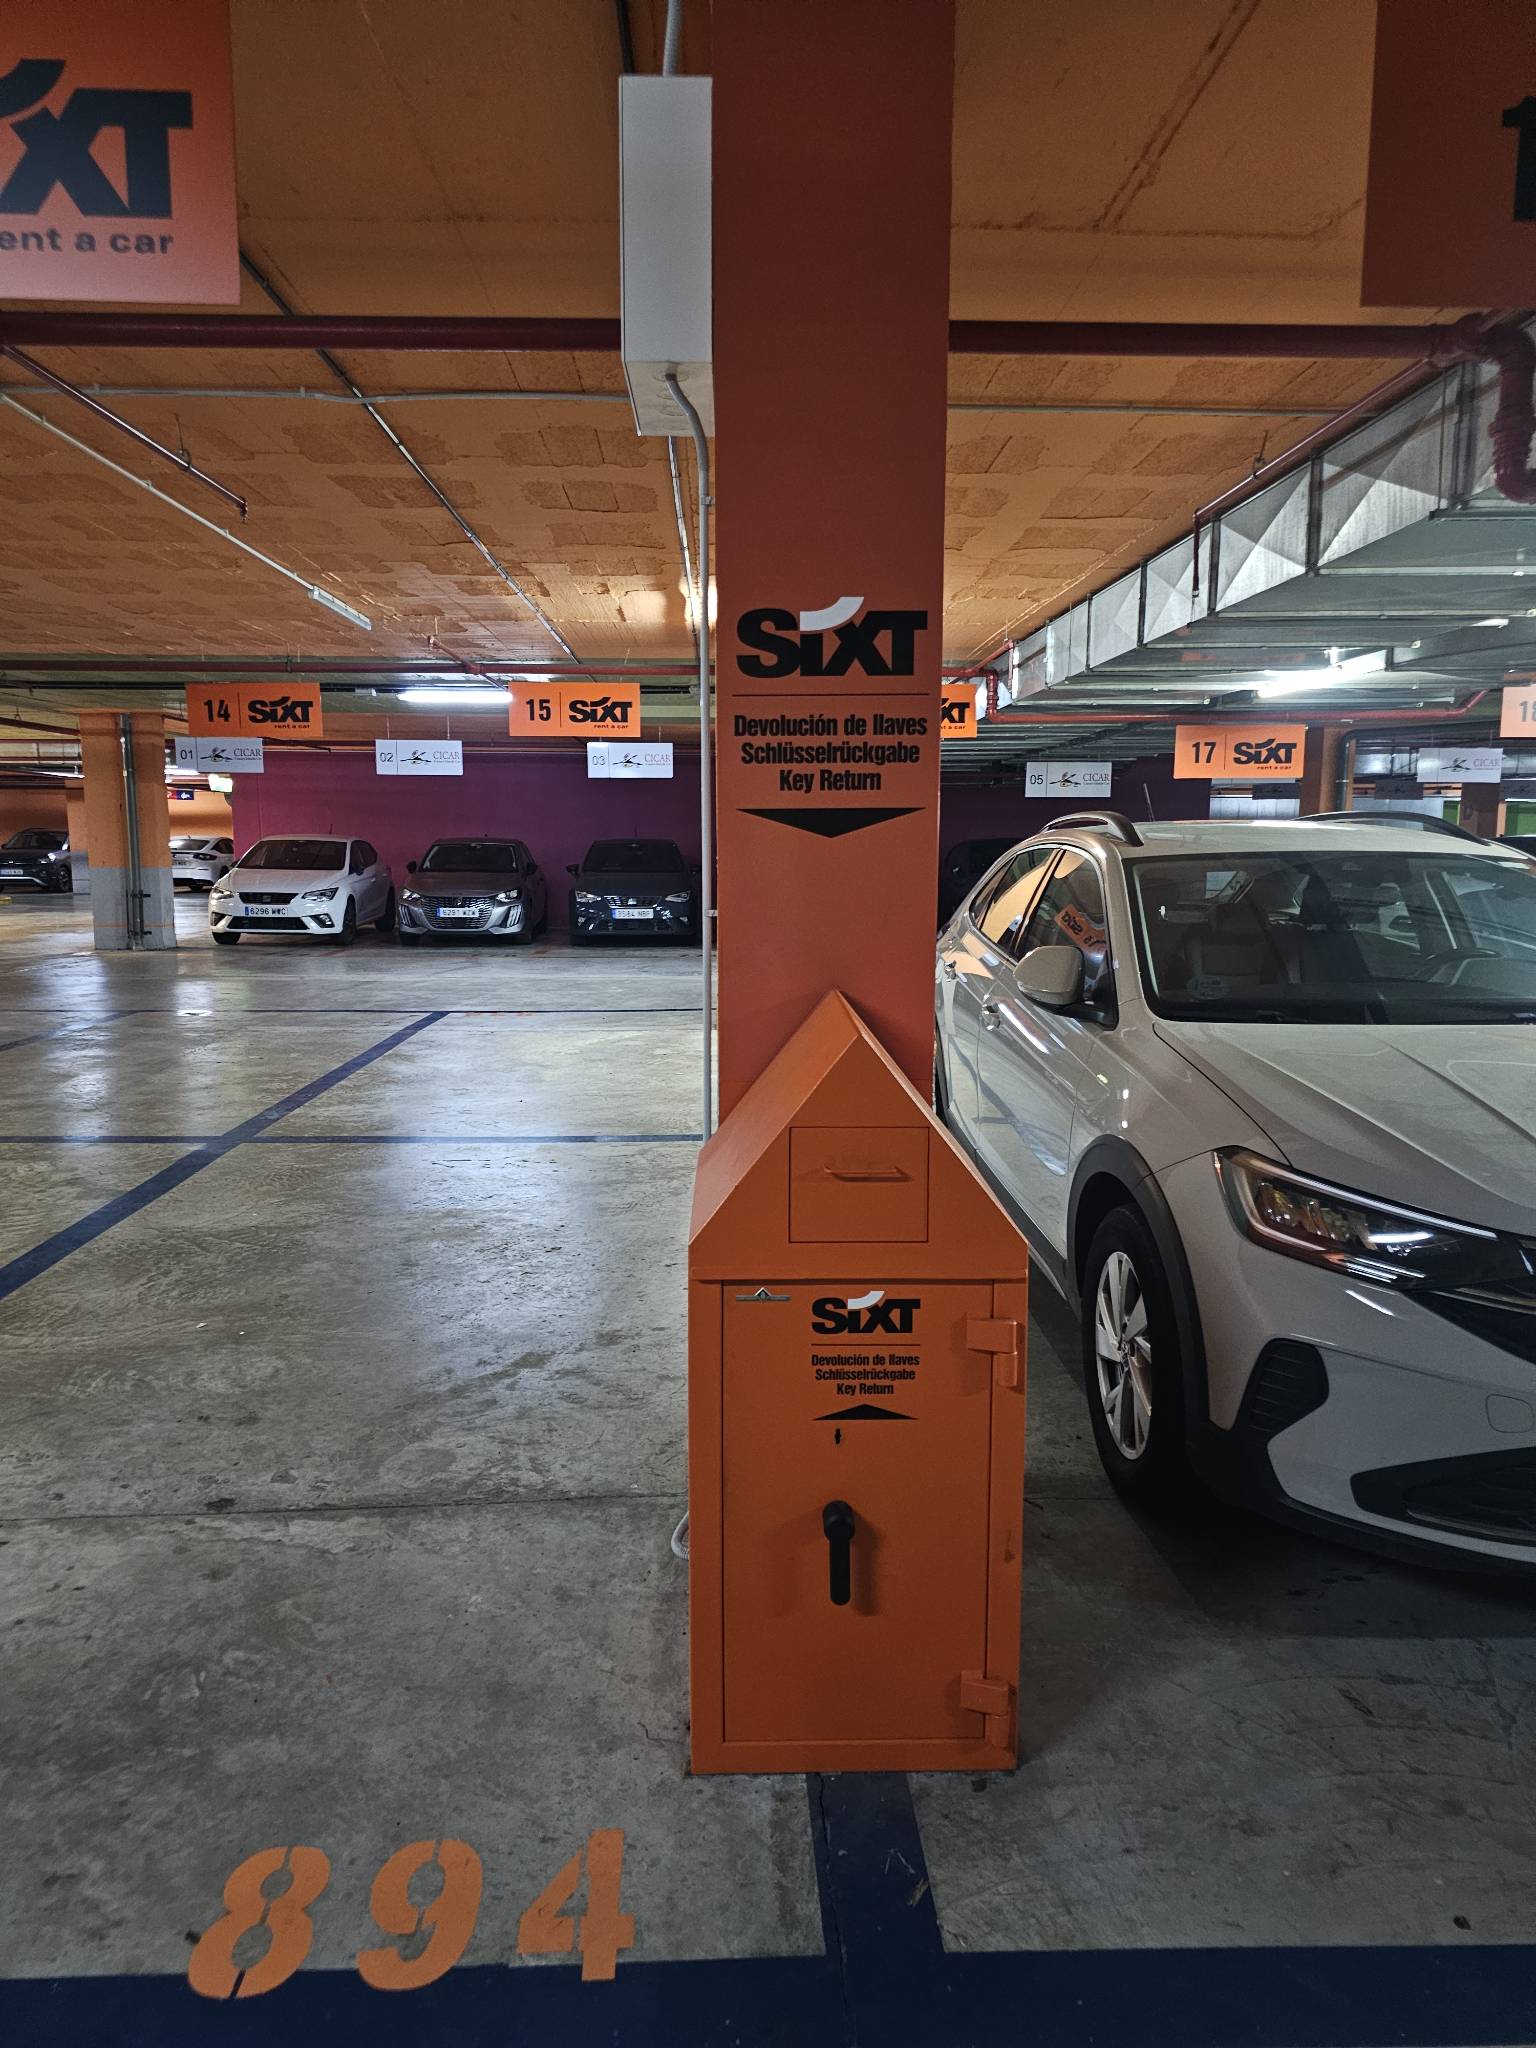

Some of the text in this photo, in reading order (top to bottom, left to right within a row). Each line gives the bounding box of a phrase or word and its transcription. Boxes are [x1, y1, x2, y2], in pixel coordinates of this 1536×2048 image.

[74, 232, 96, 252] a
[110, 233, 174, 254] car
[736, 596, 928, 679] SIXT
[203, 696, 314, 724] 14 SIXT
[526, 696, 633, 723] 15 SIXT
[941, 697, 970, 724] XT
[734, 713, 928, 737] Devolución de llaves
[180, 748, 263, 760] 01 CICAR
[380, 751, 460, 763] 02 CICAR
[592, 753, 671, 766] 03 CICAR
[740, 741, 920, 766] Schlüsselrückgabe
[1192, 738, 1297, 765] 17 SIXT
[779, 769, 882, 794] Key Return
[1030, 773, 1110, 785] 05 CICAR
[811, 1290, 921, 1335] SIXT
[811, 1354, 920, 1366] Devolución de llaves
[815, 1368, 916, 1381] Schlüsselrückgabe
[836, 1383, 894, 1396] Key Return
[187, 1828, 636, 2001] 894
